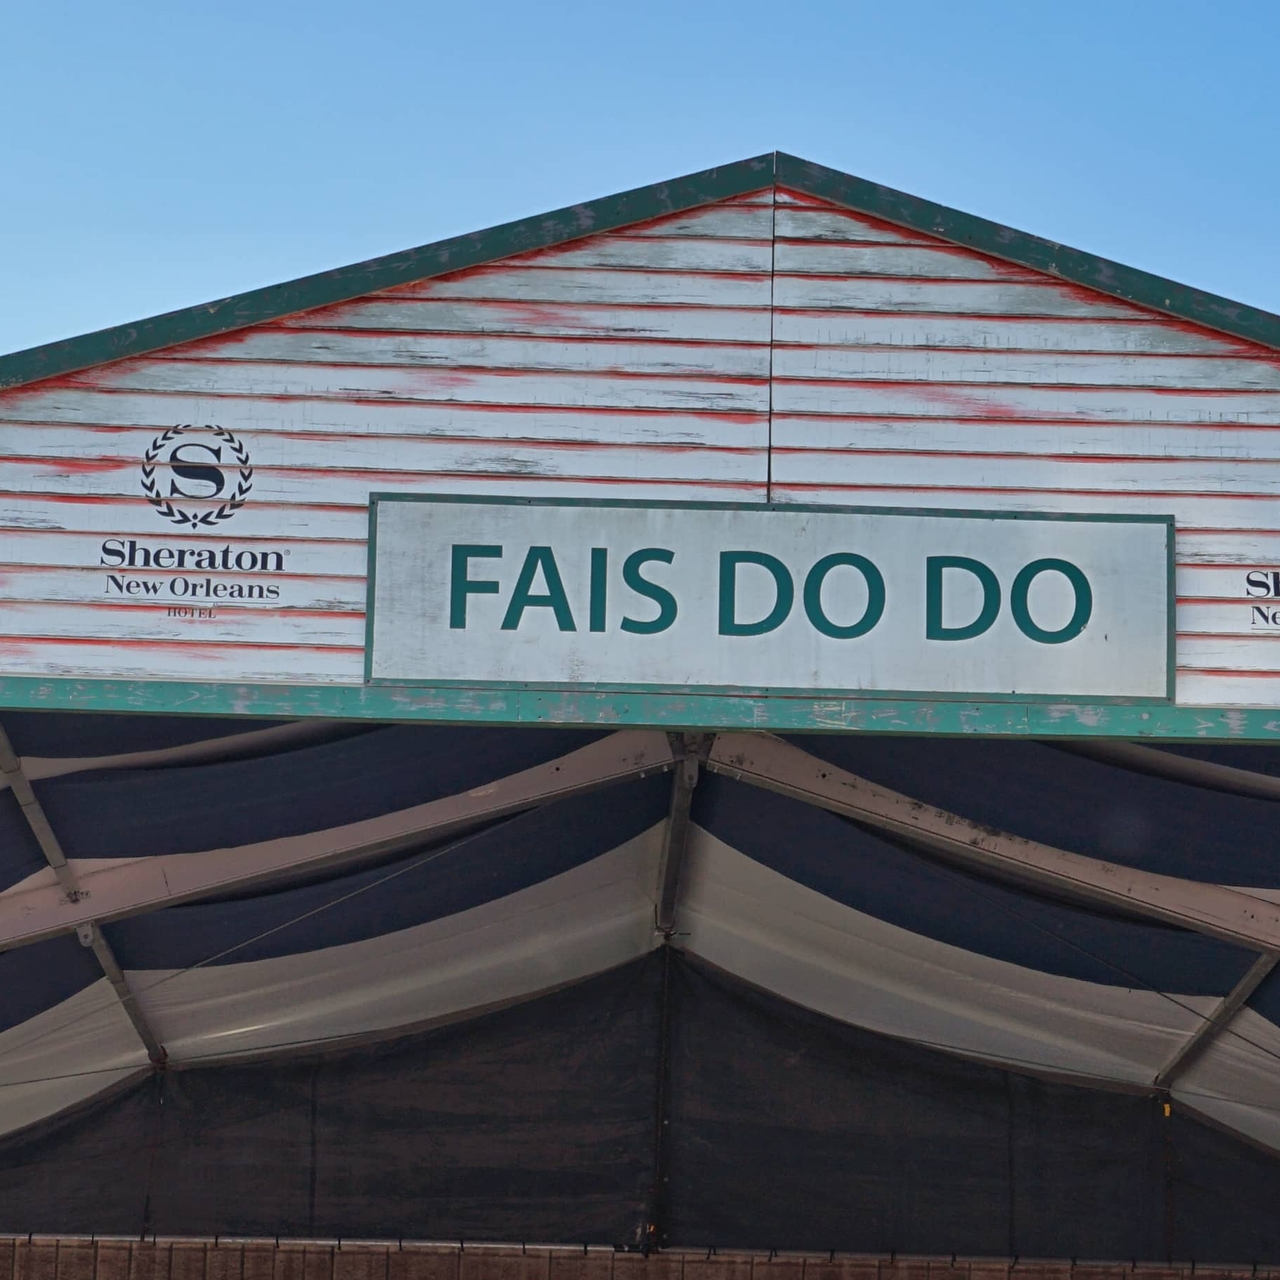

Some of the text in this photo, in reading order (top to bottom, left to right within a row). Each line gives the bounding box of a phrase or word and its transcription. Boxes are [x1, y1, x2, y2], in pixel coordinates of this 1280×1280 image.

[100, 538, 285, 571] Sheraton
[104, 575, 280, 599] New Orleans
[448, 543, 1093, 645] FAIS DO DO
[167, 607, 216, 619] HOTEL
